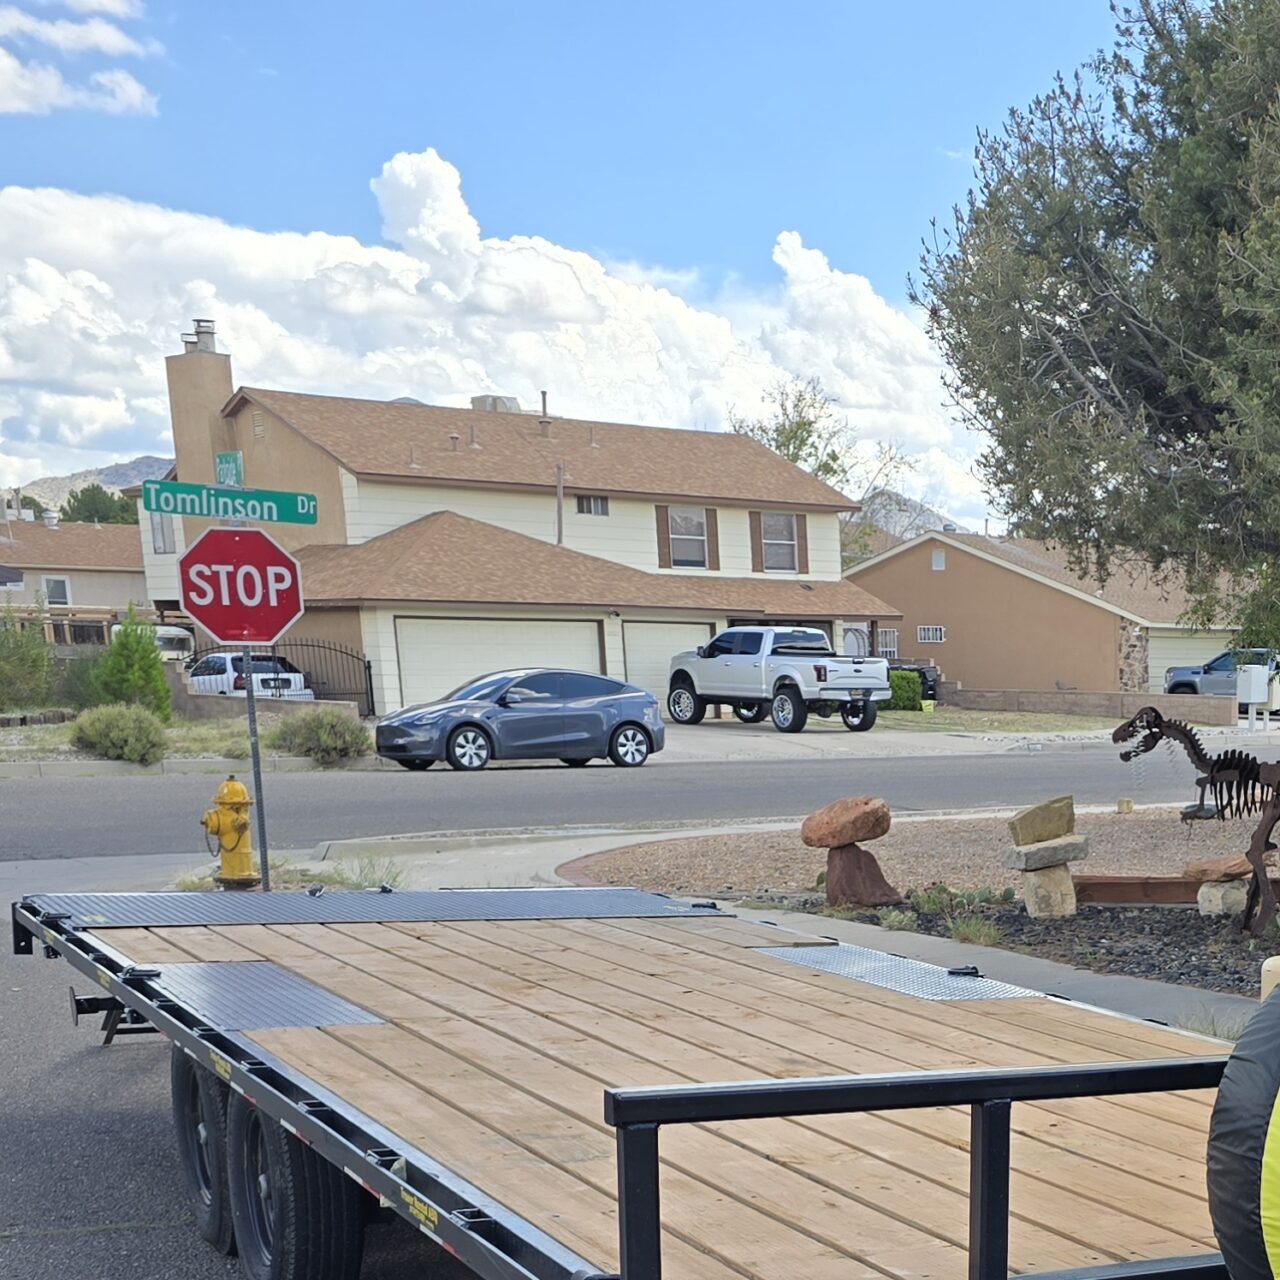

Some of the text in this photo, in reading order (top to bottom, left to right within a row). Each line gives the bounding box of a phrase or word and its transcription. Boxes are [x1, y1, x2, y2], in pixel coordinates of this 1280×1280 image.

[145, 483, 316, 521] Tomlinson Dr
[188, 563, 292, 607] STOP
